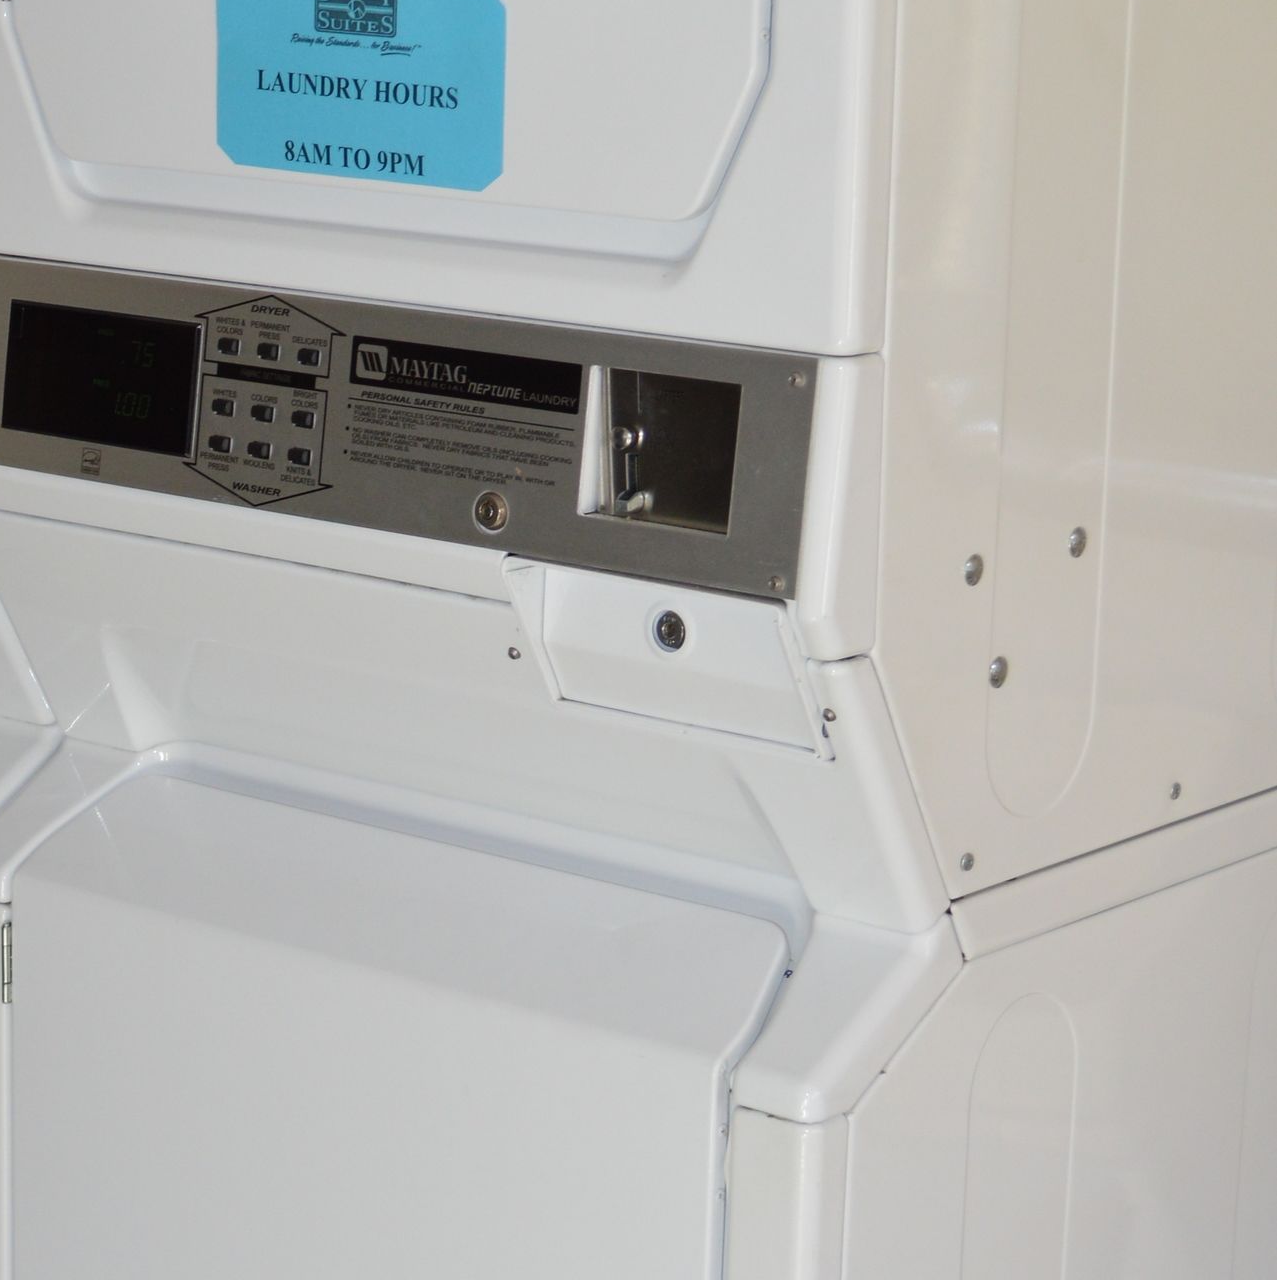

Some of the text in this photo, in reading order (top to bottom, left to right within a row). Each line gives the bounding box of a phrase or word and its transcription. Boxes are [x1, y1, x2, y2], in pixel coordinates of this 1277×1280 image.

[318, 10, 393, 34] SUITES
[257, 69, 459, 110] LAUNDRY HOURS
[284, 140, 425, 176] 8AM TO 9PM
[251, 304, 291, 317] DRYER
[389, 357, 468, 385] MAYTAG
[361, 391, 485, 415] PERSONAL SAFETY RULES
[467, 382, 578, 407] NEPTUNE LAUNDRY
[232, 481, 281, 497] WASHER
